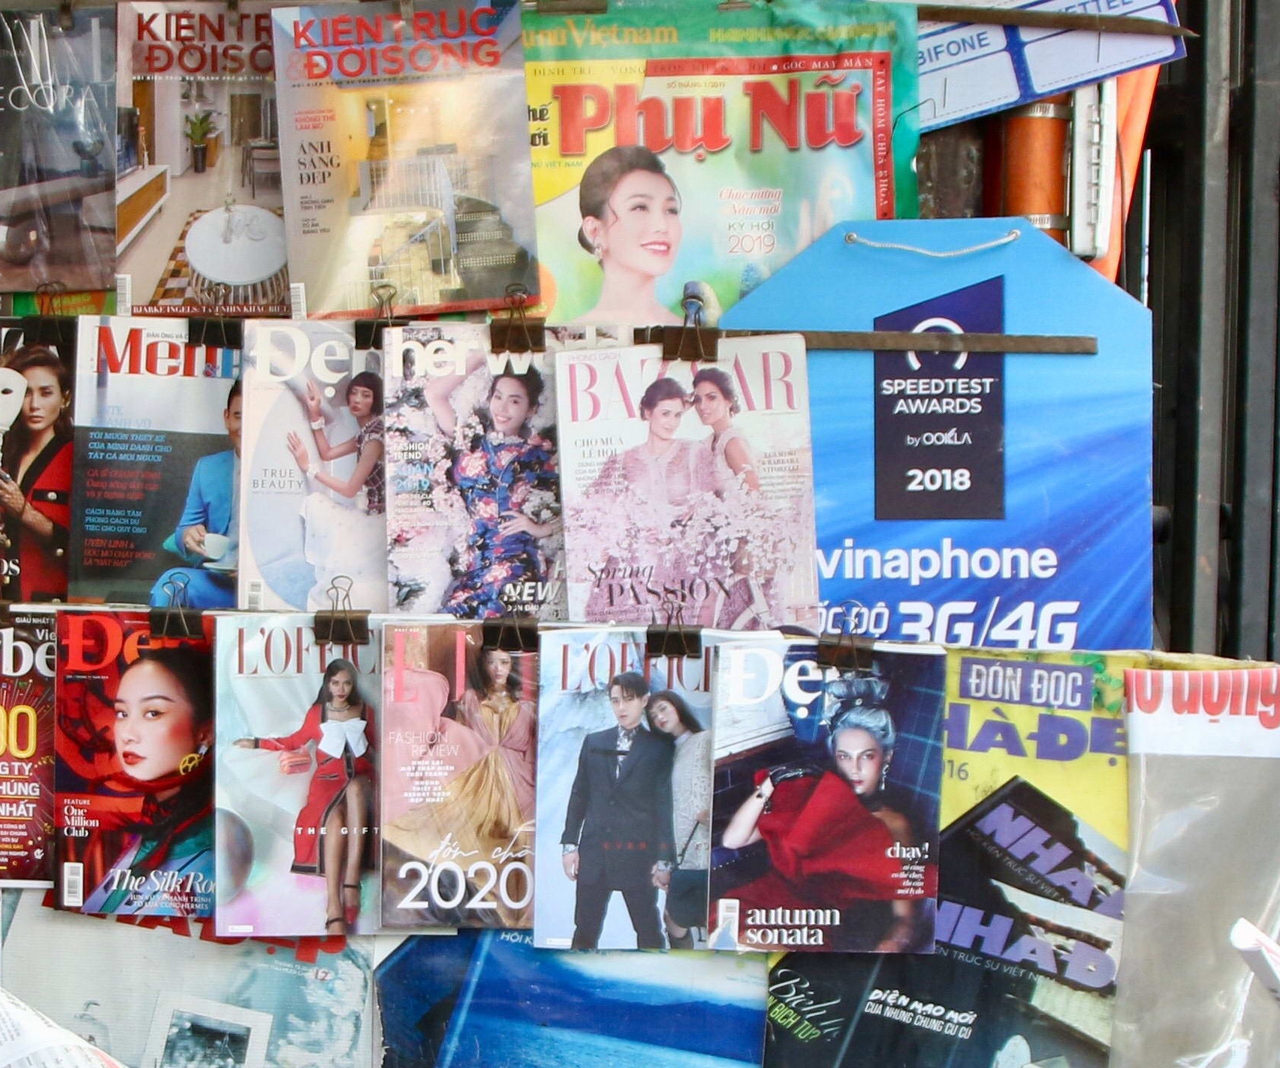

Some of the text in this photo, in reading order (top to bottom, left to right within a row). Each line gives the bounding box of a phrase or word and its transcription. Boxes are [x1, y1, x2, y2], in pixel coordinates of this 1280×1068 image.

[552, 73, 864, 162] Phụ Nữ
[728, 233, 776, 254] 2019
[881, 377, 994, 395] SPEEDTEST
[893, 397, 983, 414] AWARDS
[906, 433, 922, 447] by
[252, 478, 304, 489] BEAUTY
[906, 468, 972, 491] 2018
[816, 537, 1058, 586] vinaphone
[969, 661, 1023, 701] ĐÓN
[1031, 668, 1083, 710] ĐỌC
[389, 731, 448, 745] FASHION
[412, 745, 461, 757] REVIEW
[64, 815, 100, 828] Million
[296, 826, 328, 836] THE
[109, 868, 185, 894] The Silk
[397, 860, 534, 910] 2020
[747, 906, 841, 928] autumn
[746, 925, 825, 946] sonata
